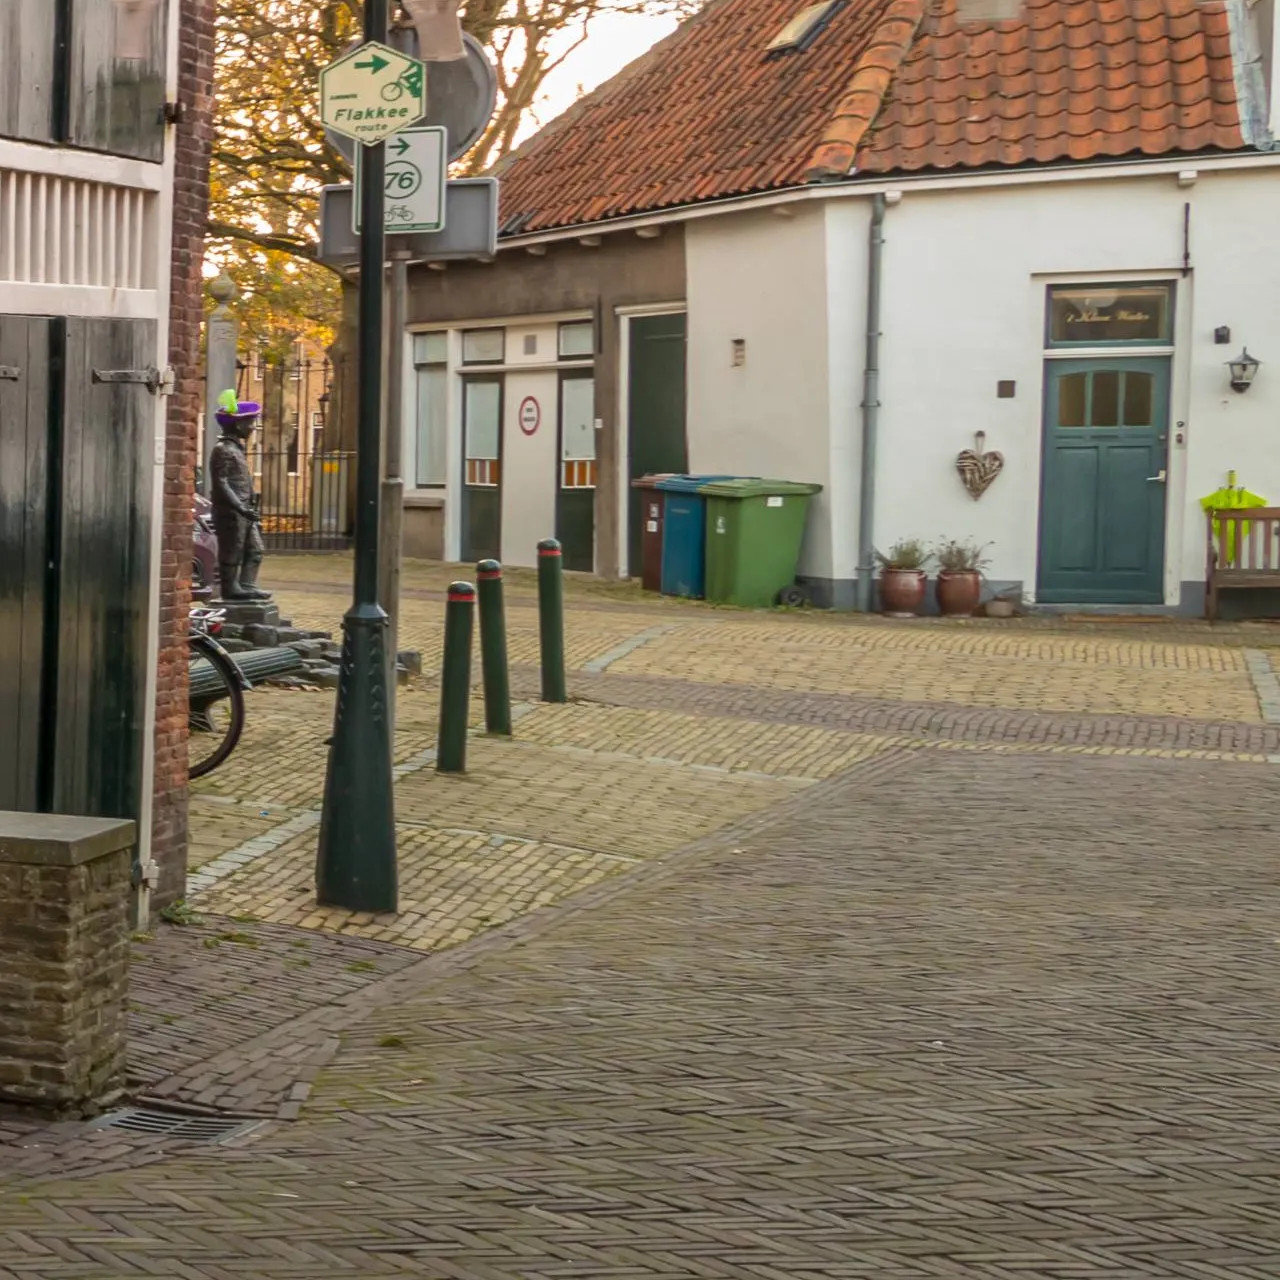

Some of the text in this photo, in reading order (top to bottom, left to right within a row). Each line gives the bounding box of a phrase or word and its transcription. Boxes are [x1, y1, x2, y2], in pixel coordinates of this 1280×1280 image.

[334, 106, 409, 122] Flakkee
[354, 123, 388, 132] route
[384, 171, 414, 190] 76
